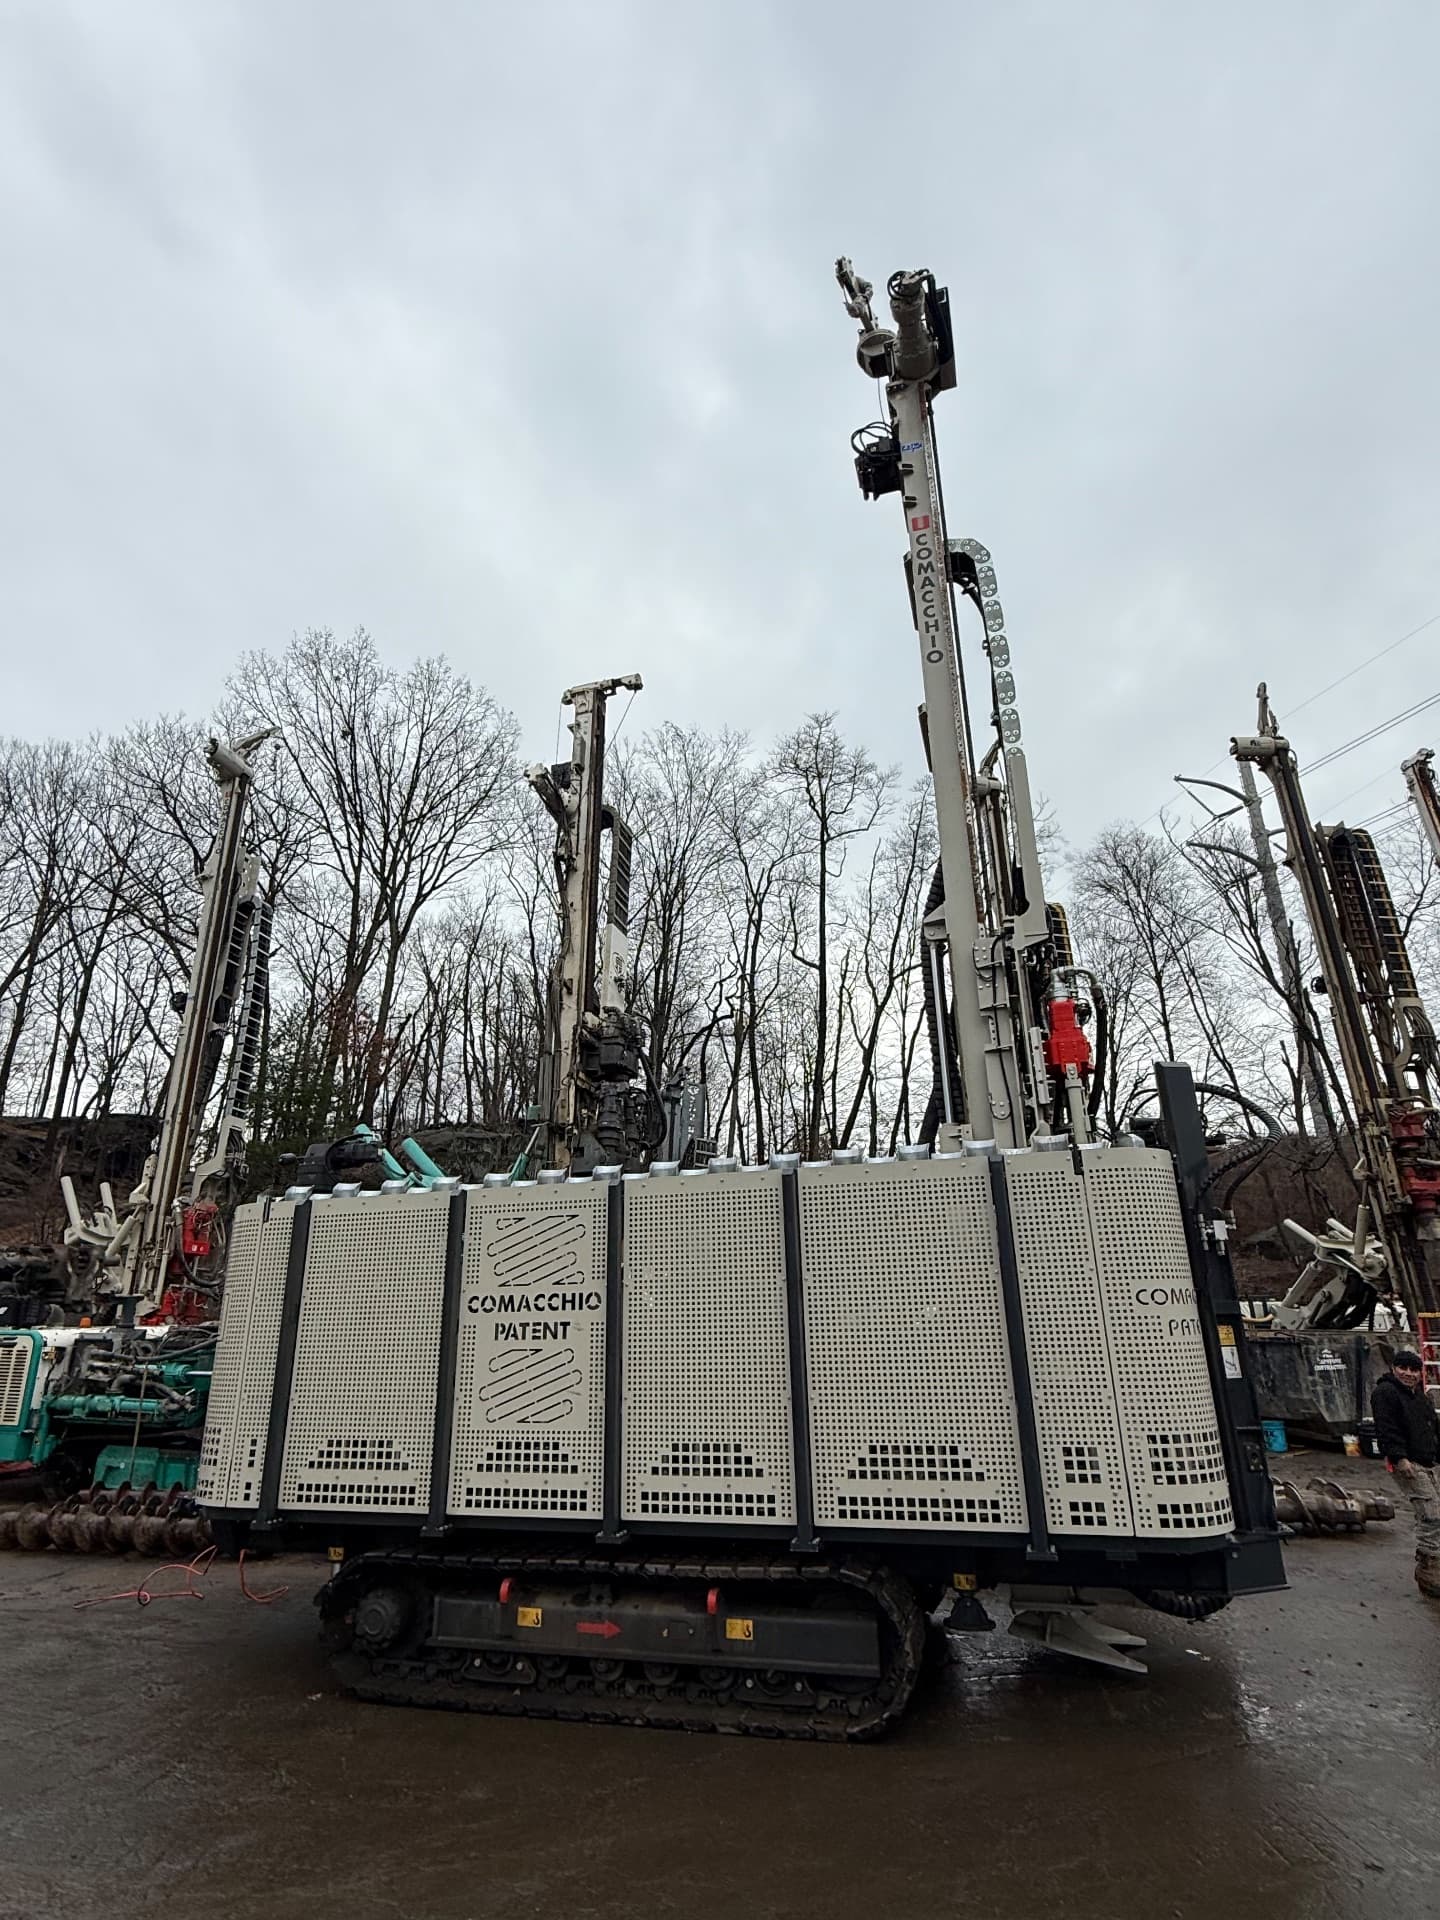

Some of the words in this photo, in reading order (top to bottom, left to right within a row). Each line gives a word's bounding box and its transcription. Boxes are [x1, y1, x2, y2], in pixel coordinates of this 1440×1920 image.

[916, 533, 944, 664] COMACCHIO
[467, 1291, 602, 1314] COMACCHIO
[494, 1321, 571, 1341] PATENT
